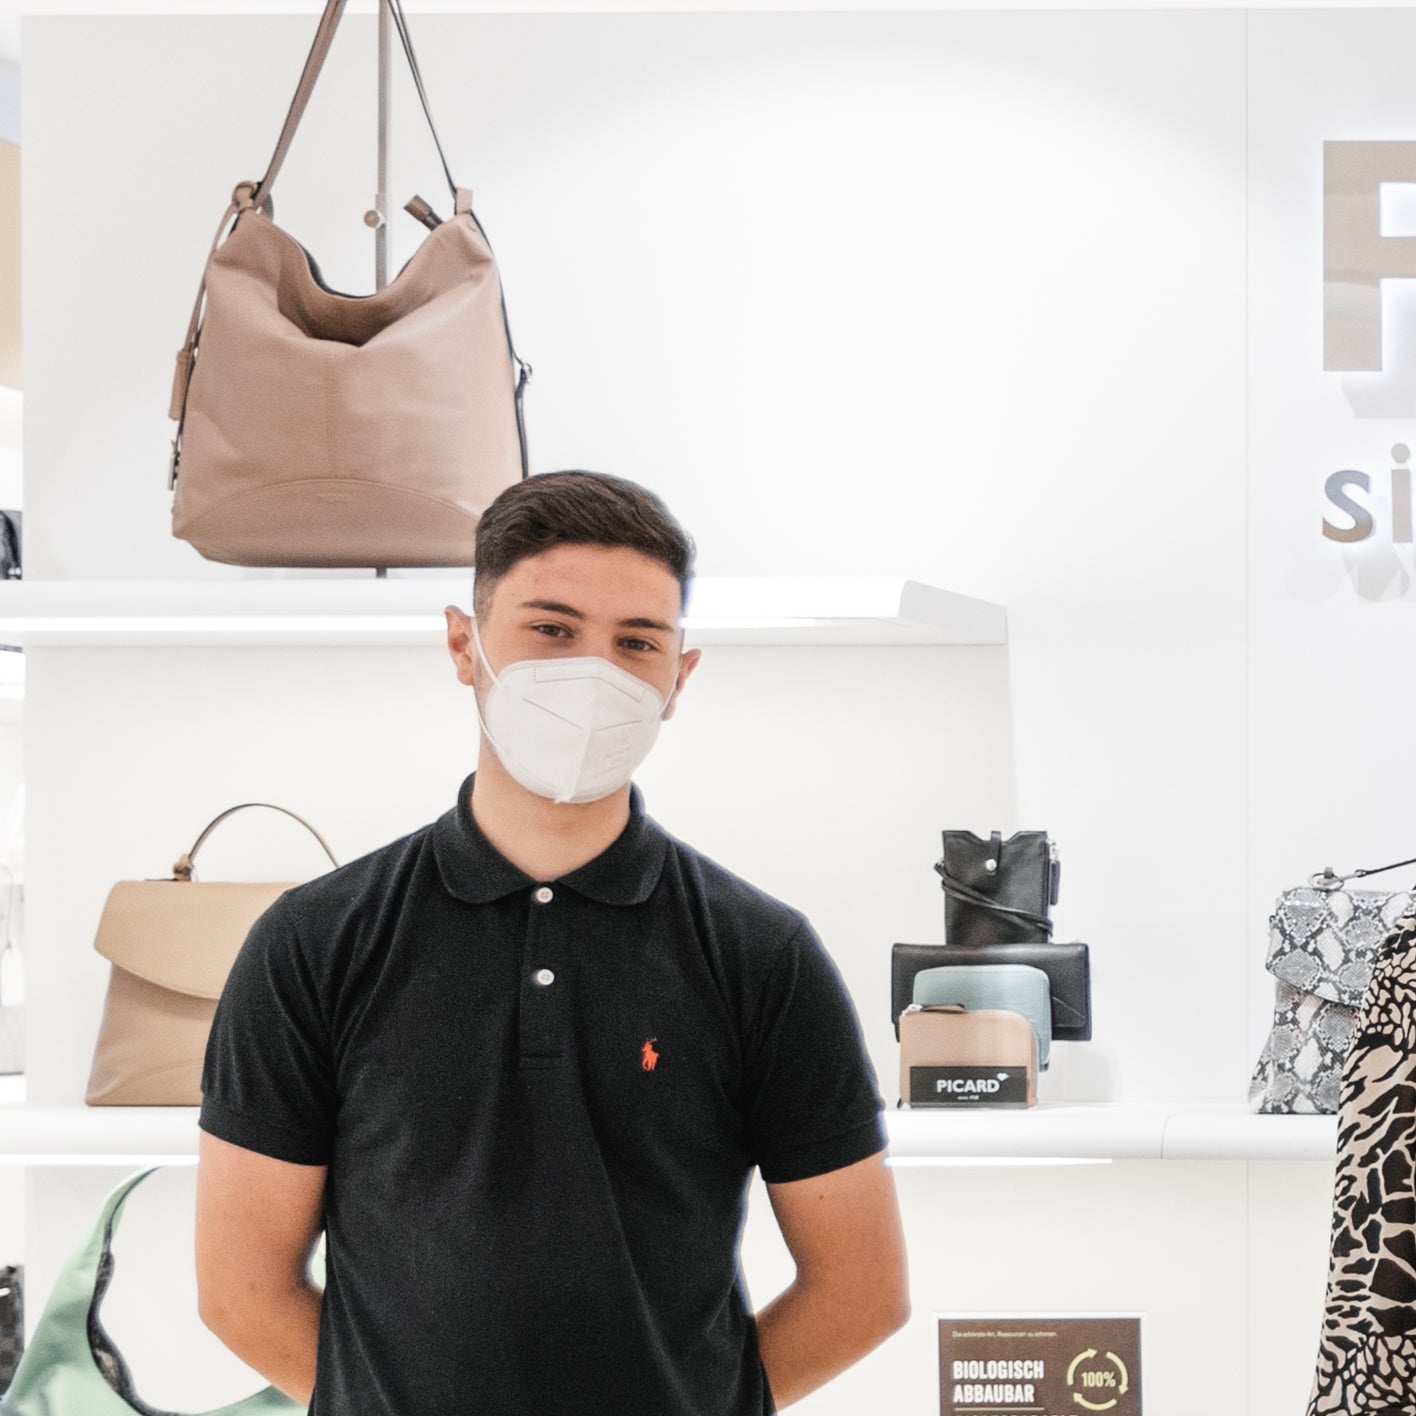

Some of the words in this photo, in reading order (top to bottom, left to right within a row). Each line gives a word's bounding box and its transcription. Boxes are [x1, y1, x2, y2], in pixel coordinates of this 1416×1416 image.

[936, 1079, 1000, 1093] PICARD
[953, 1360, 1045, 1379] BIOLOGISCH
[1081, 1371, 1116, 1387] 100%
[953, 1384, 1035, 1403] ABBAUBAR
